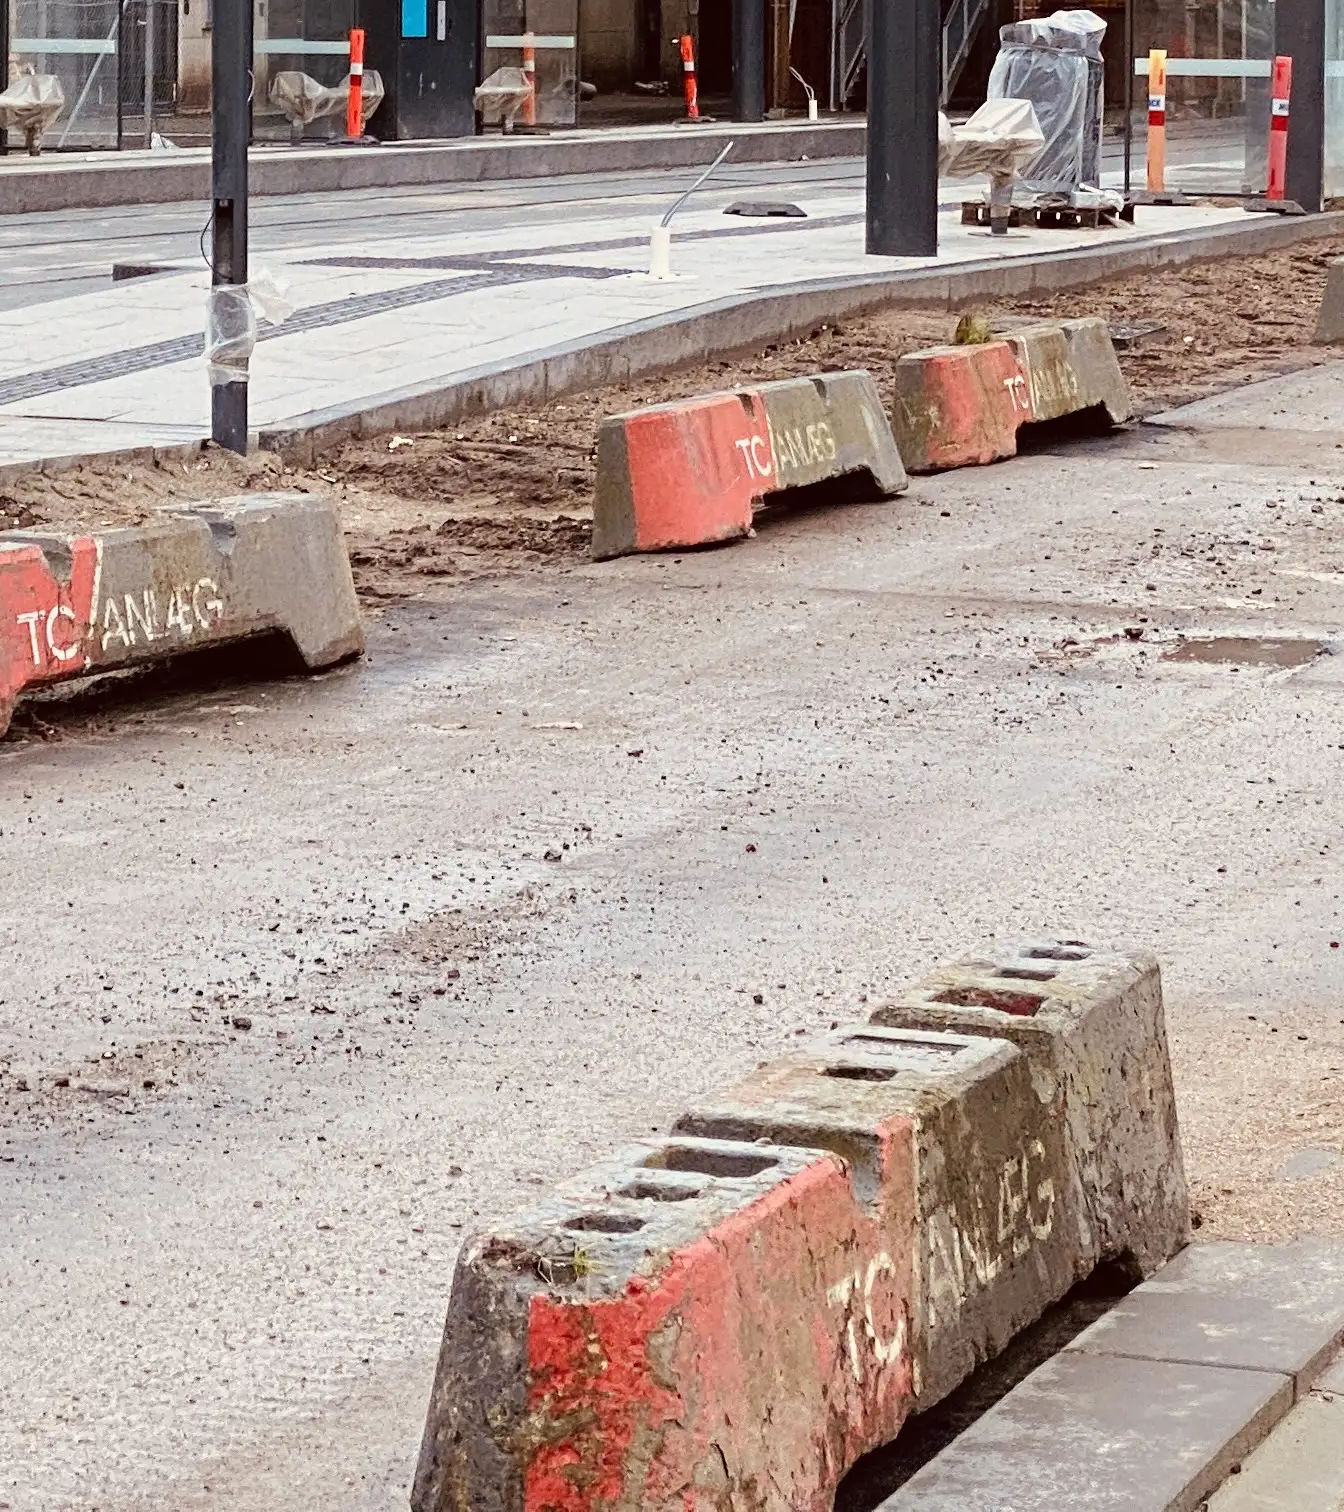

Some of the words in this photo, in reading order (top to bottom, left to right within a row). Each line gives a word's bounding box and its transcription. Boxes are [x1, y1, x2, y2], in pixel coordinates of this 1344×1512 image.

[1003, 375, 1029, 412] TC
[735, 434, 771, 479] TC
[16, 604, 81, 665] TC
[826, 1251, 905, 1382] TC
